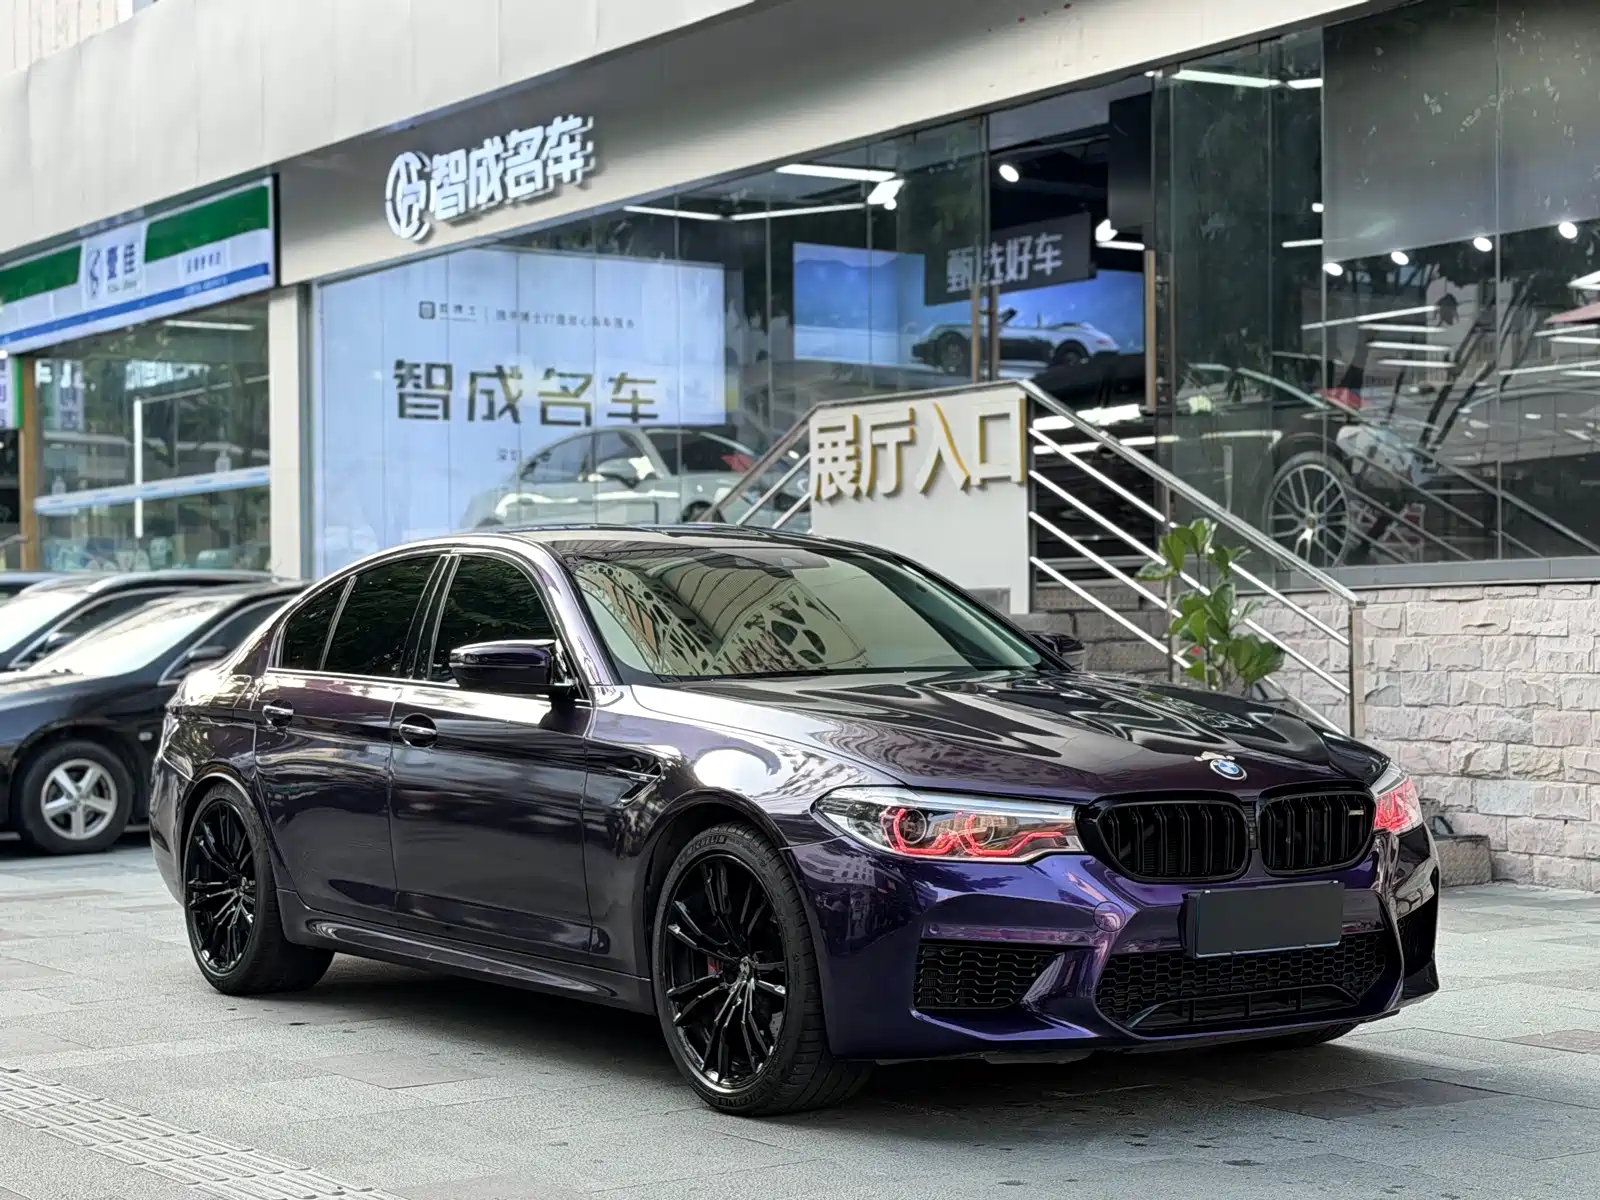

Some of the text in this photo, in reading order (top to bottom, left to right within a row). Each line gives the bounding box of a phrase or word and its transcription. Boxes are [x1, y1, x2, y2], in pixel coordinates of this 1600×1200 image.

[430, 115, 592, 220] 智成名车
[394, 358, 659, 427] 智成名车
[813, 395, 1026, 502] 展厅入口
[686, 835, 727, 854] MICHELIN
